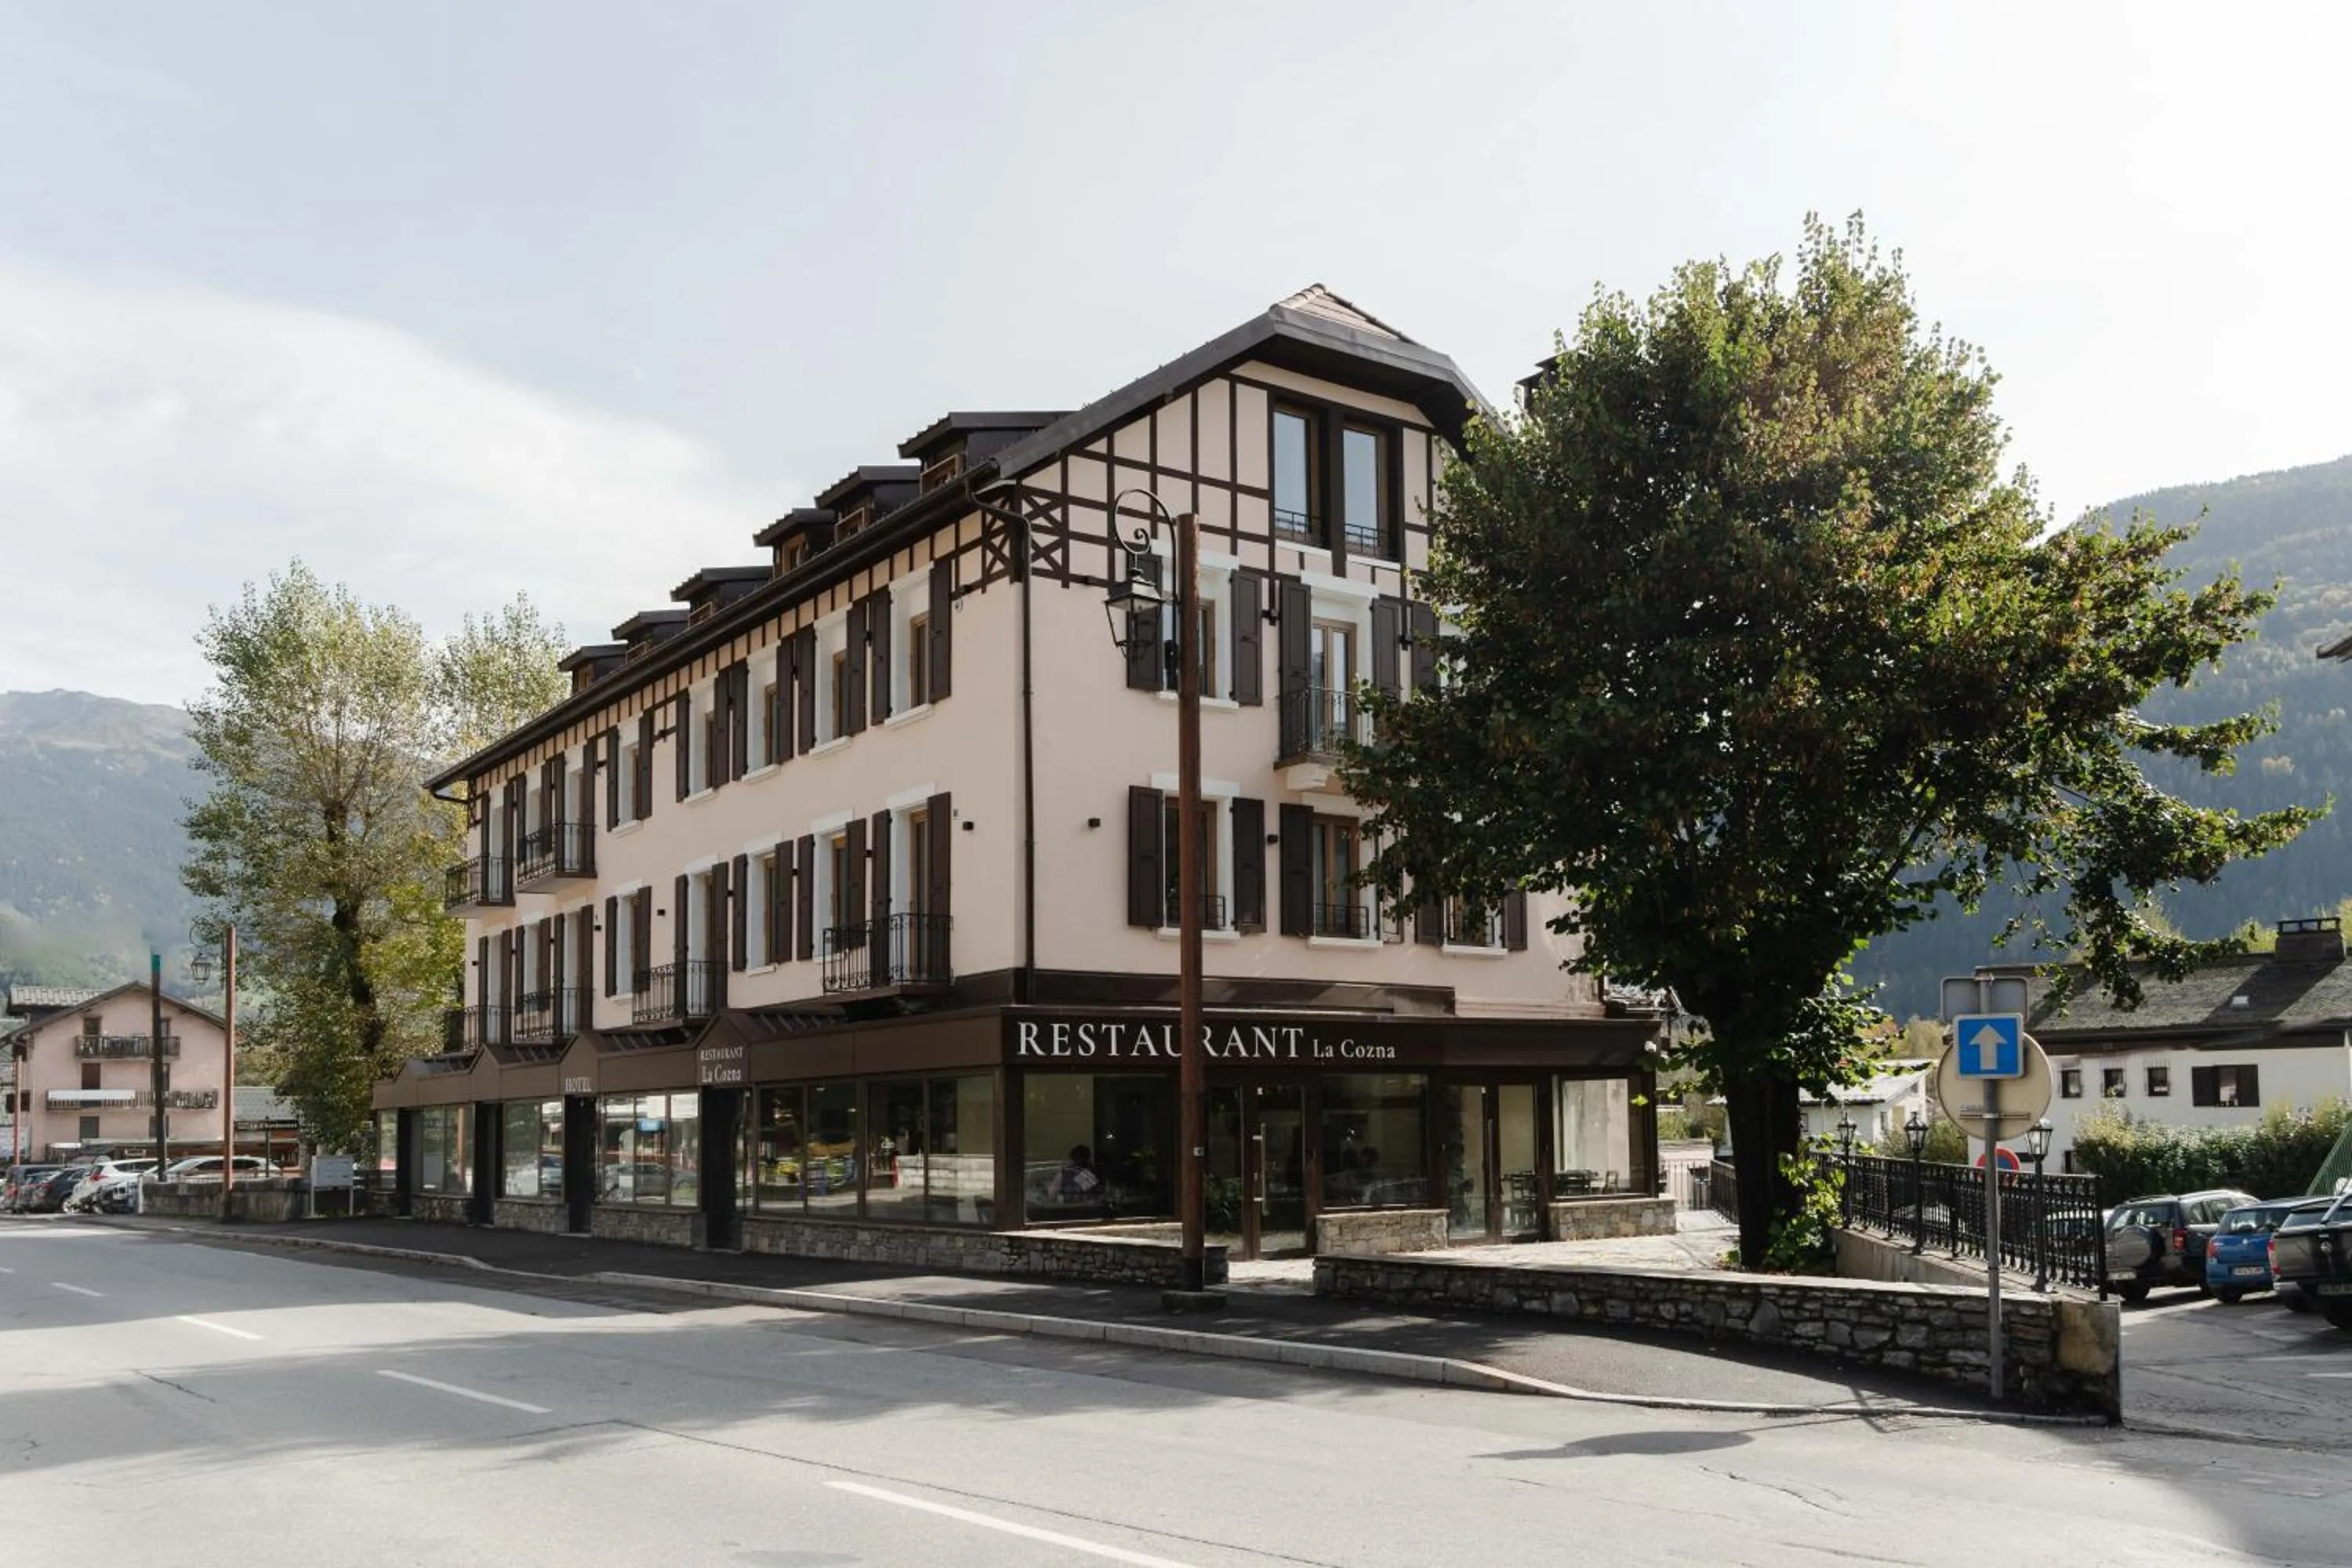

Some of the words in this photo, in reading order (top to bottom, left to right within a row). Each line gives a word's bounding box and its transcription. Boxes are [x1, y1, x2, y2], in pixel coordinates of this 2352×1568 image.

[701, 1047, 743, 1061] RESTAURANT
[1312, 1039, 1334, 1058] La
[1341, 1039, 1396, 1058] Cozna
[702, 1065, 713, 1083] La
[565, 1076, 592, 1092] HOTEL
